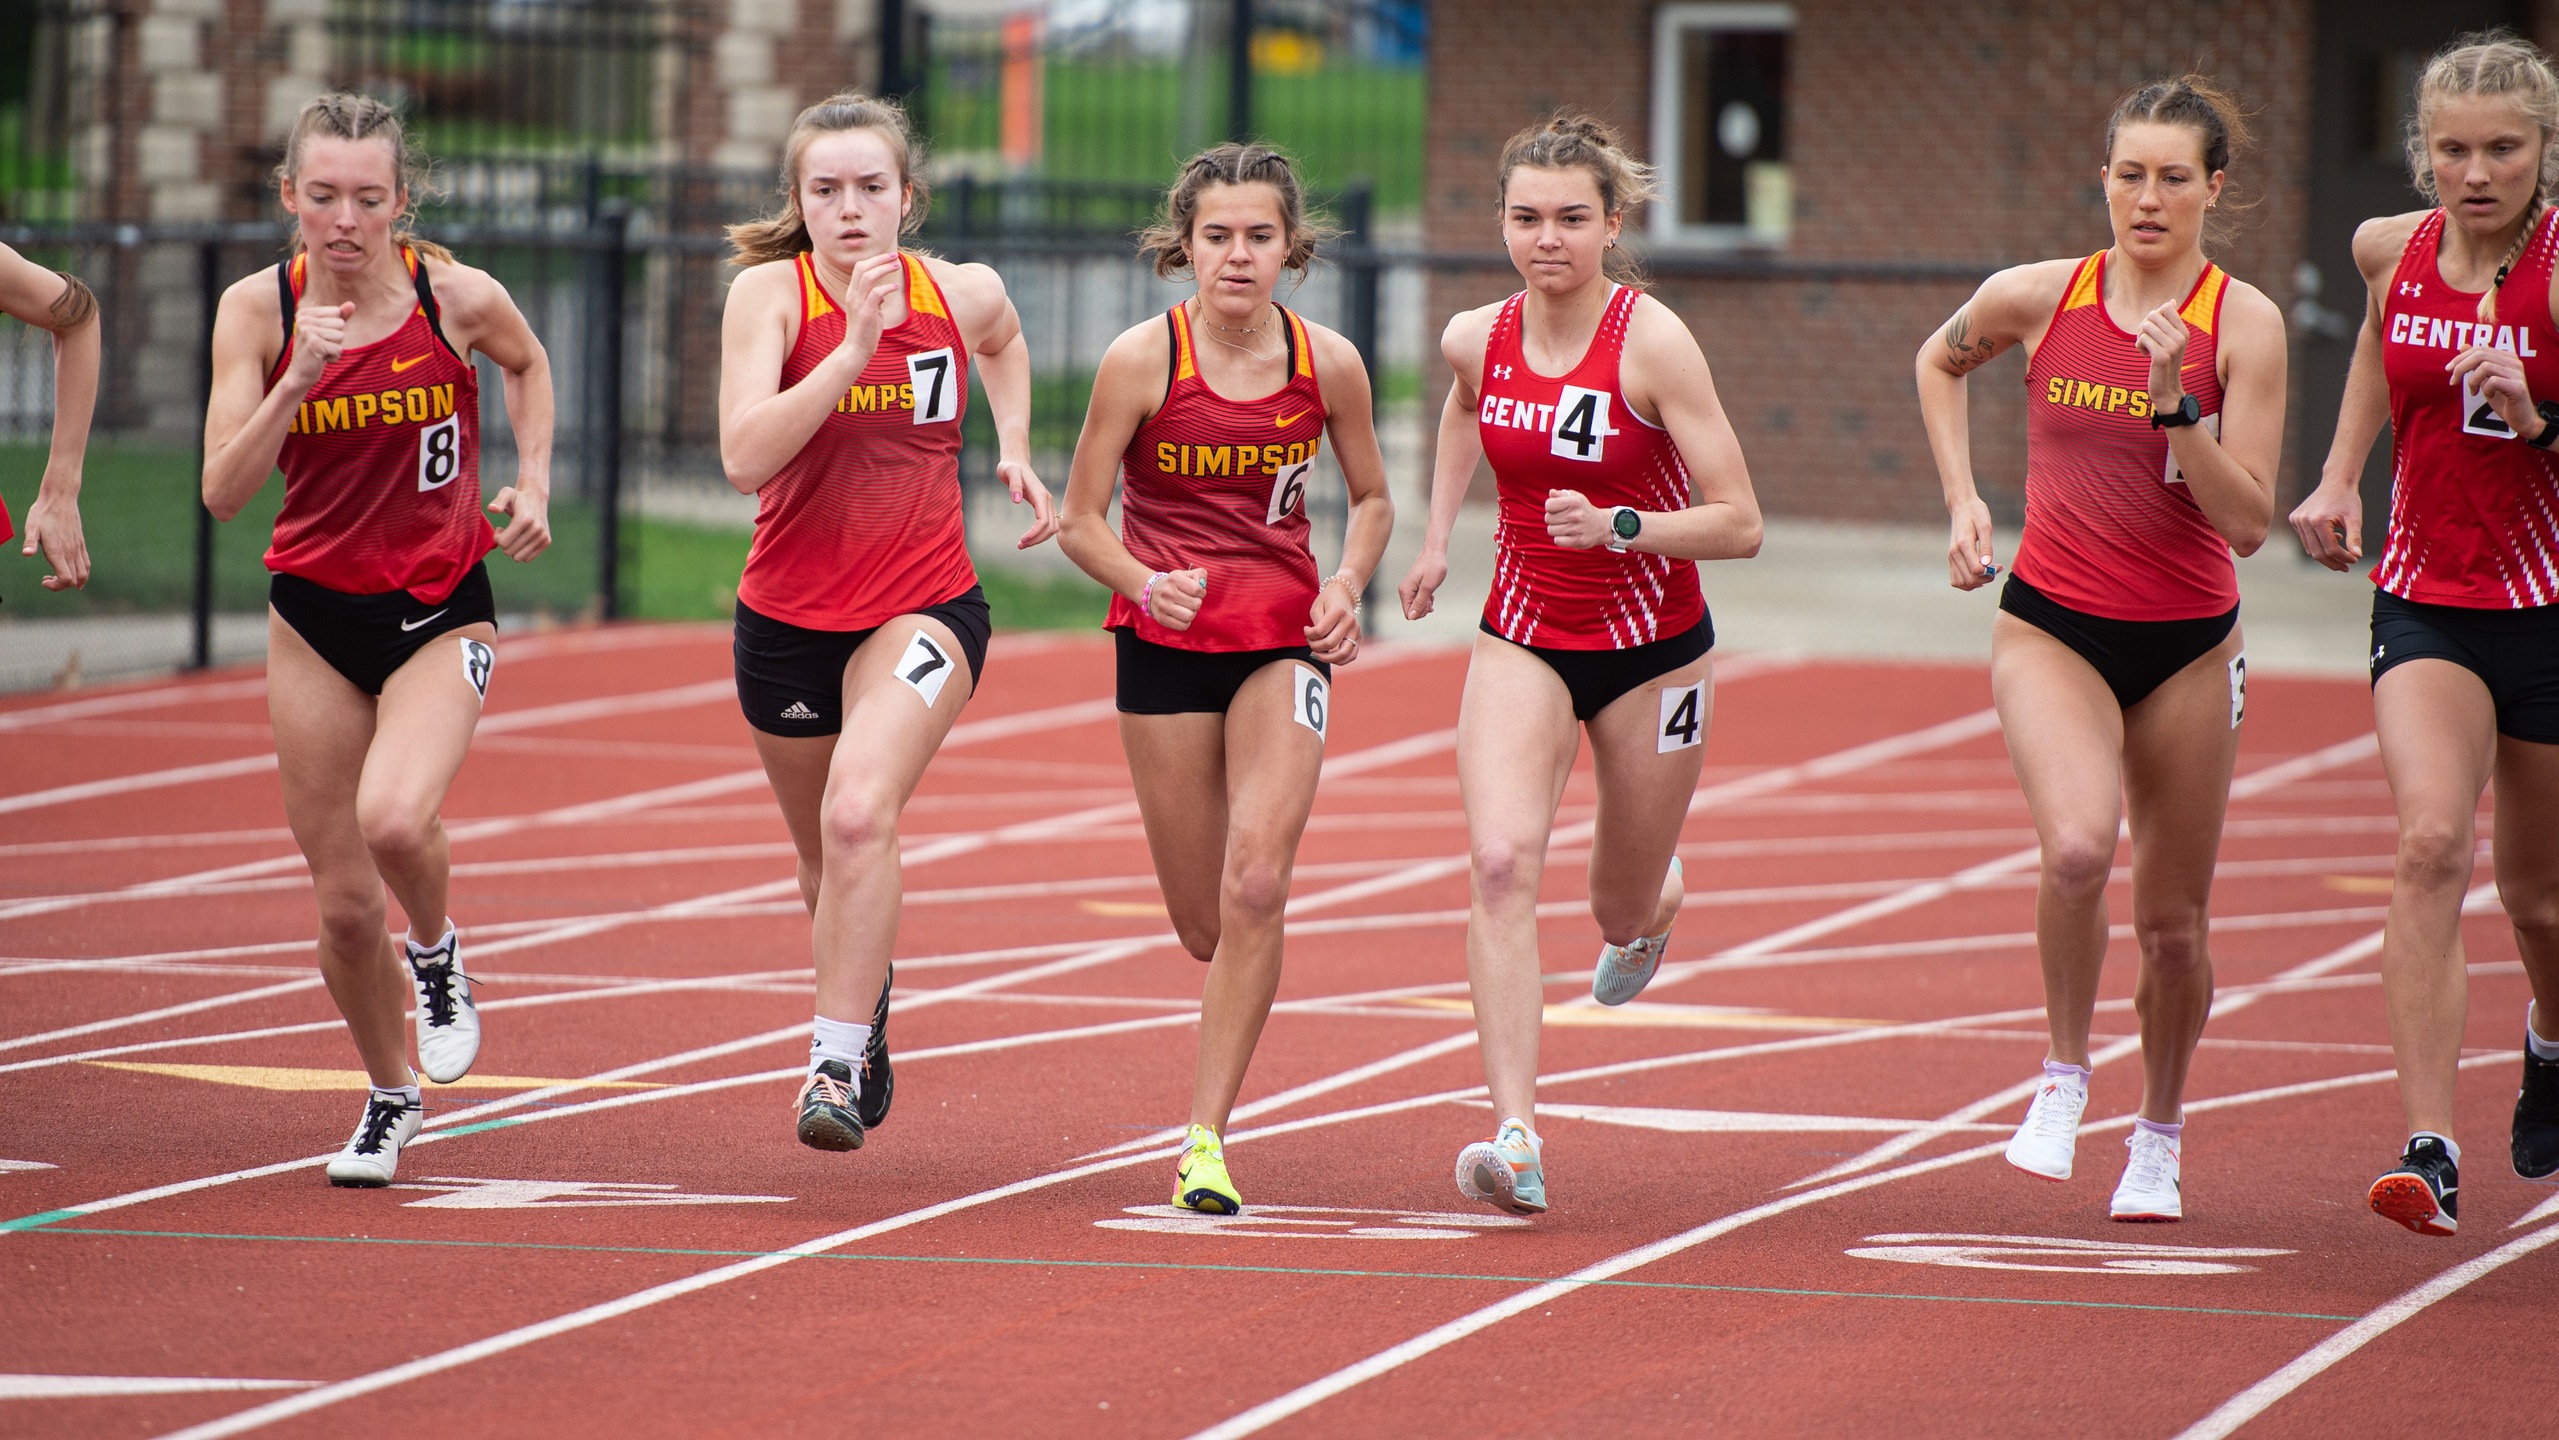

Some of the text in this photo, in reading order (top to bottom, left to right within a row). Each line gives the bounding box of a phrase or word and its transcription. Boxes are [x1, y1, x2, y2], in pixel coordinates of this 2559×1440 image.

[2391, 312, 2537, 358] CENTRAL
[288, 382, 455, 435] IMPSON
[914, 355, 948, 419] 7
[2047, 376, 2157, 418] SIMPS
[1558, 393, 1597, 456] 4
[425, 424, 455, 484] 8
[1278, 462, 1309, 517] 6
[468, 641, 491, 697] 8
[906, 636, 947, 685] 7
[780, 711, 819, 719] adidas
[1305, 677, 1324, 732] 6
[1664, 688, 1699, 745] 4
